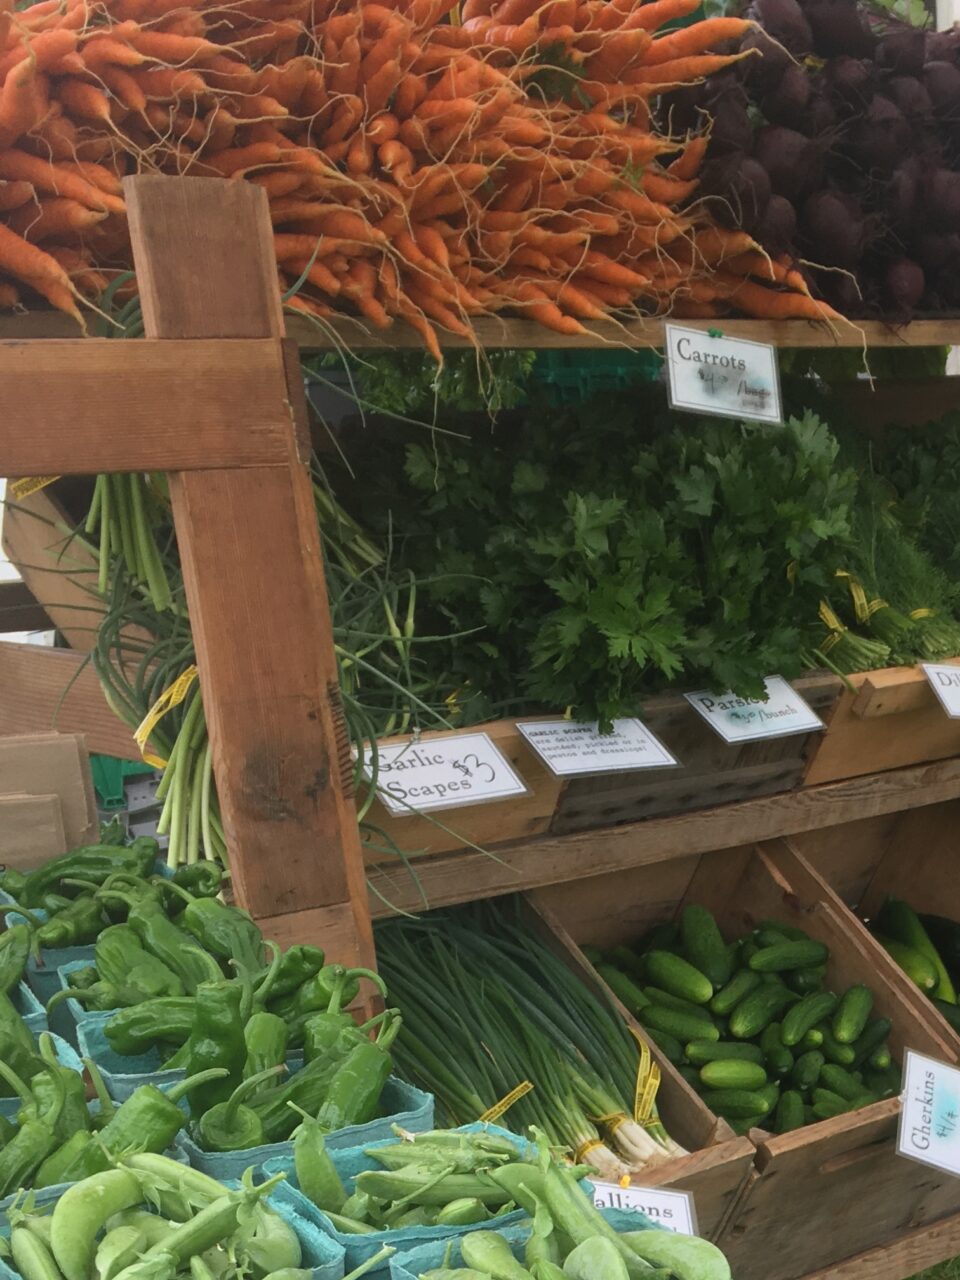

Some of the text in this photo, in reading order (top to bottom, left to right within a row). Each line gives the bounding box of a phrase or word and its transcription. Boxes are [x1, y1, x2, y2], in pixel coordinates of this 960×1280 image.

[677, 337, 746, 371] Carrots
[370, 749, 443, 773] Garlic
[451, 753, 496, 783] $3
[386, 779, 472, 800] Scapes
[911, 1070, 936, 1150] Gherkins
